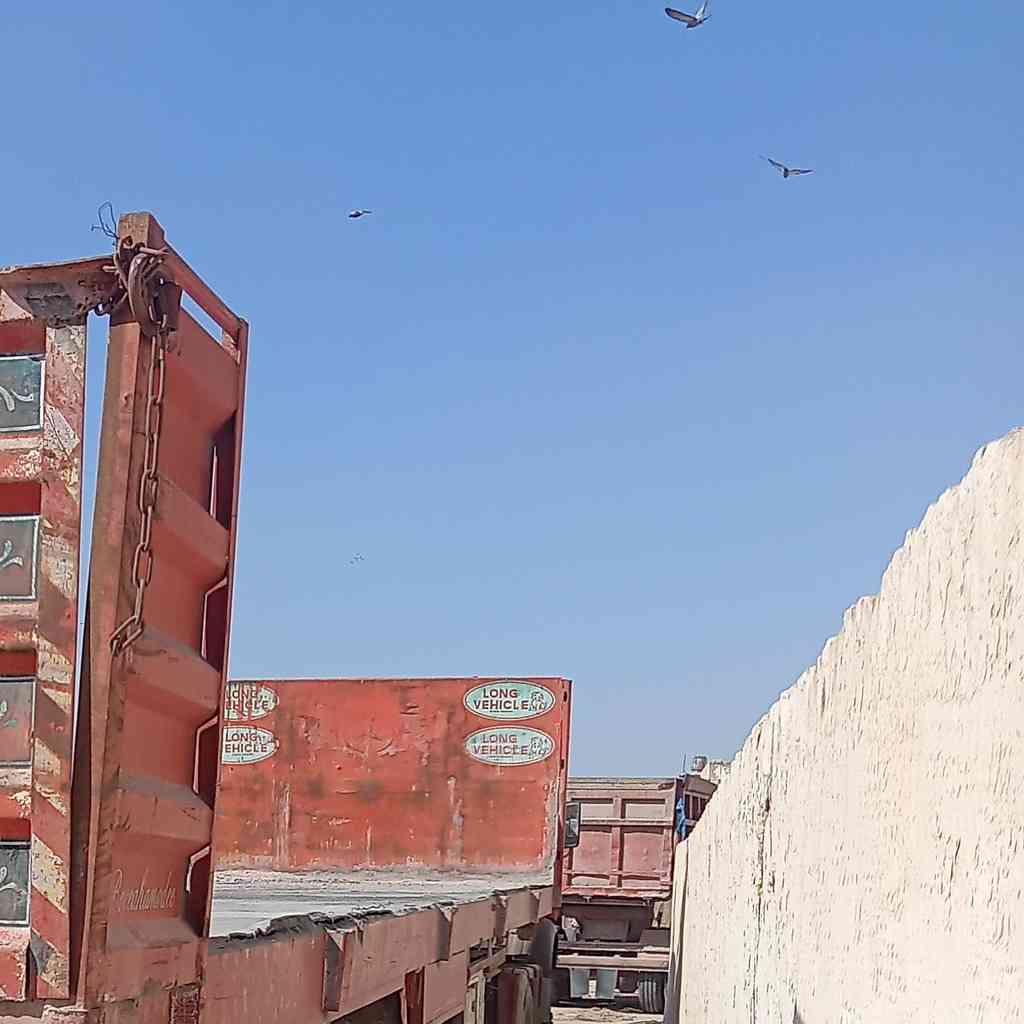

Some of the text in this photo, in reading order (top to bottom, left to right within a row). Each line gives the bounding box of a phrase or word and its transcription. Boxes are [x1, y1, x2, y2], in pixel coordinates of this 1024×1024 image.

[483, 688, 518, 699] LONG
[473, 700, 529, 710] VEHICLE
[226, 733, 257, 743] LONG
[483, 734, 518, 744] LONG
[225, 744, 267, 753] EHICLE
[473, 745, 529, 755] VEHICLE
